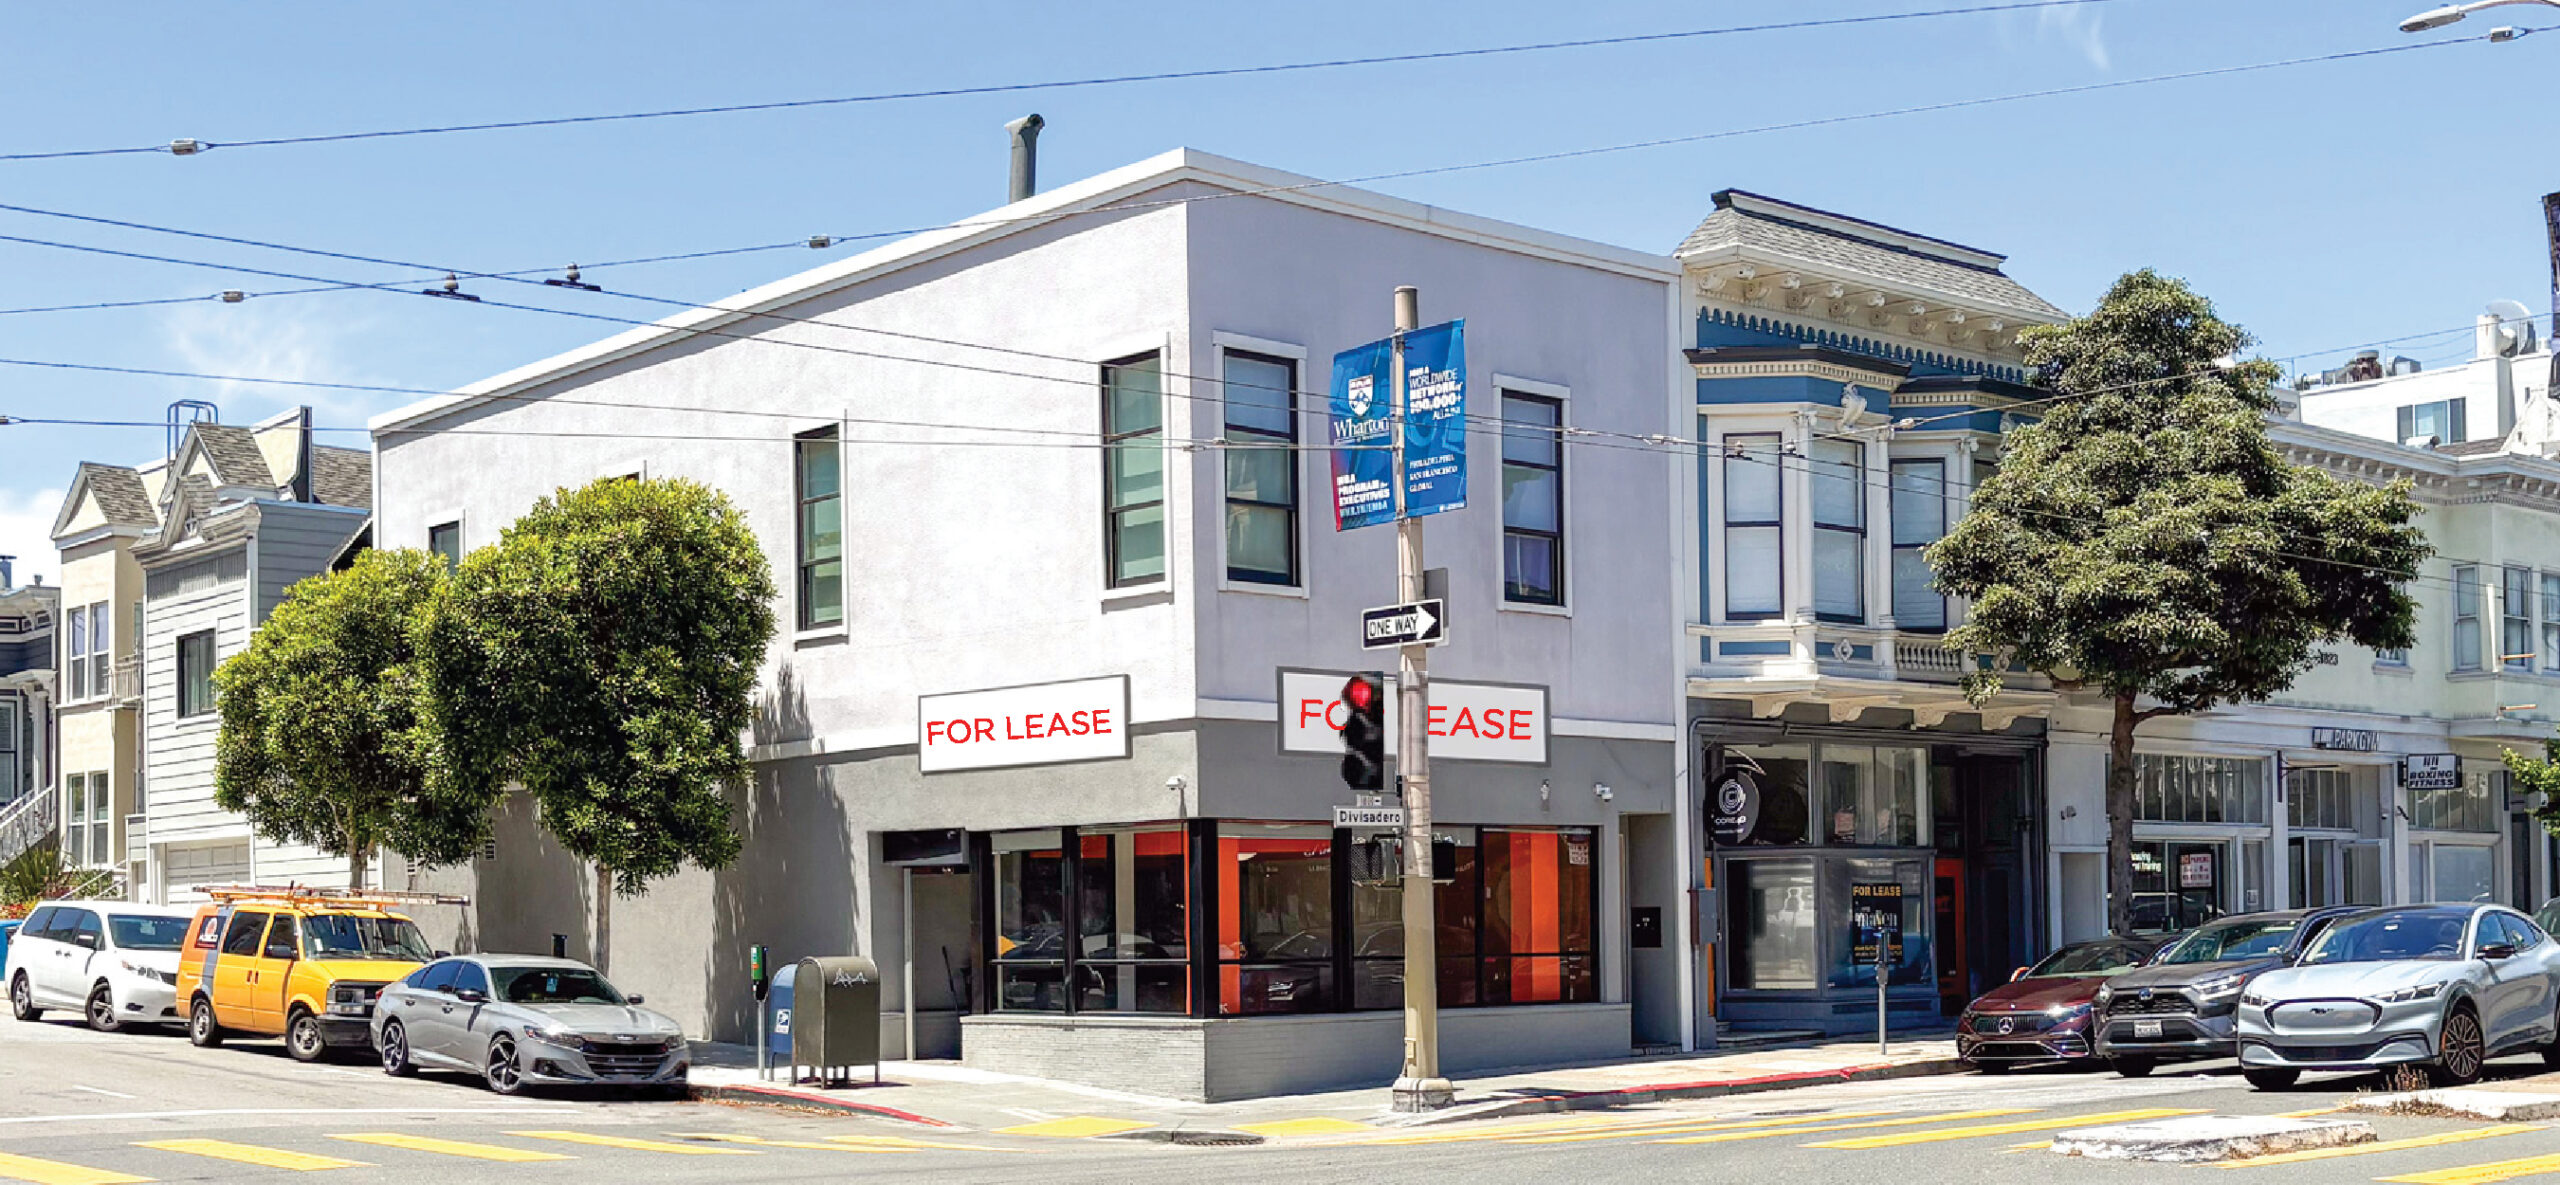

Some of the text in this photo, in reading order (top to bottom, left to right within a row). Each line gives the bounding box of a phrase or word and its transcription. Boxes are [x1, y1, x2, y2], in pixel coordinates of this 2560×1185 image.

[1333, 416, 1389, 438] Wharton
[1368, 615, 1419, 637] ONE WAY
[927, 709, 1112, 746] FOR LEASE
[1427, 705, 1533, 741] EASE
[2409, 770, 2453, 779] BOXING
[2409, 778, 2454, 787] FITNESS
[1339, 810, 1401, 823] Divisadero
[1853, 885, 1901, 897] FOR LEASE
